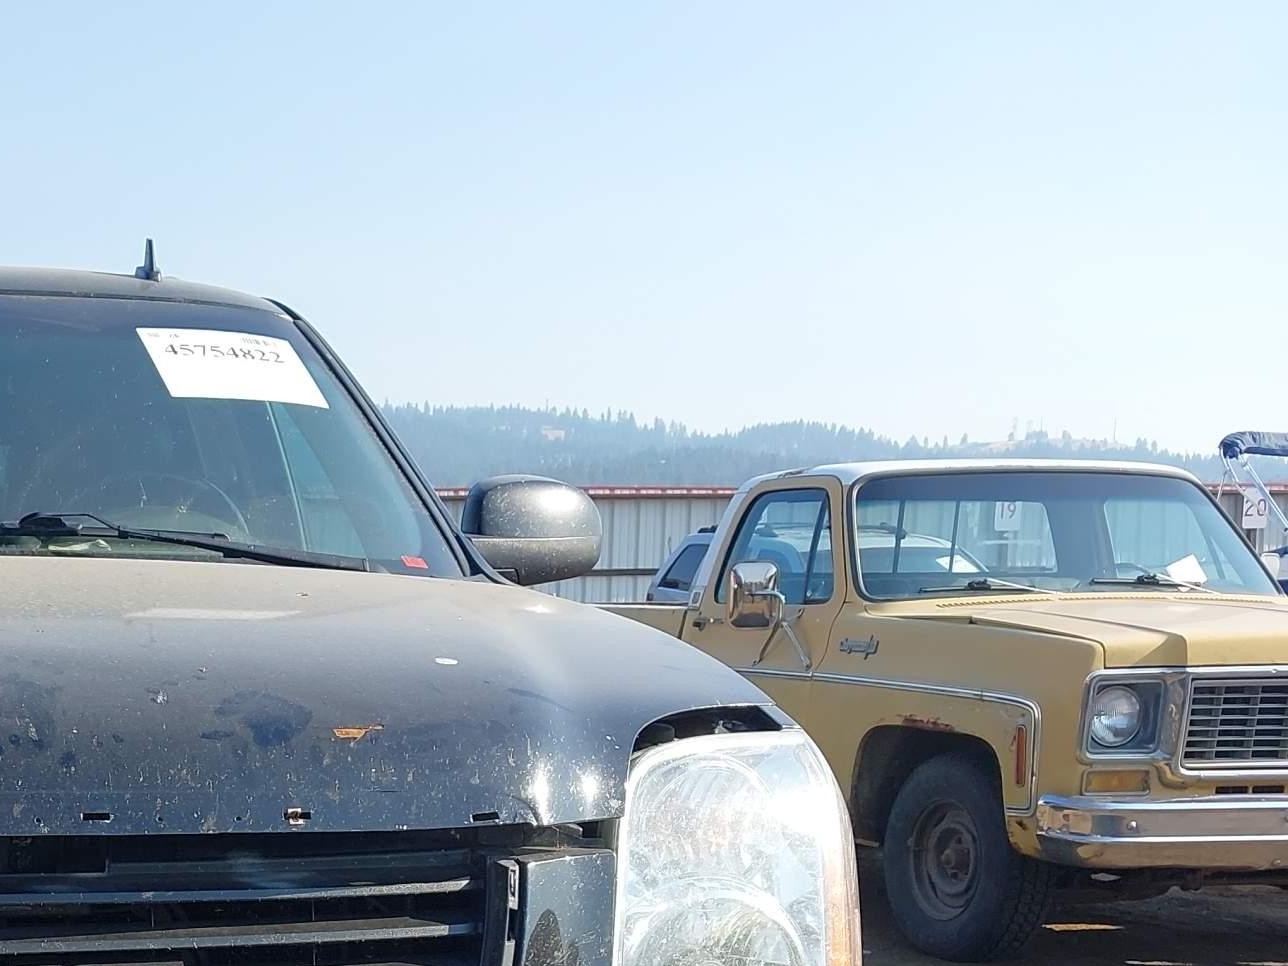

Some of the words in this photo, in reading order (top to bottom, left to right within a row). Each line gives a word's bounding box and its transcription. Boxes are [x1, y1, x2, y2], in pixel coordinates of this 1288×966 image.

[165, 344, 285, 363] 45754822
[1000, 502, 1017, 519] 19
[1245, 498, 1267, 517] 20
